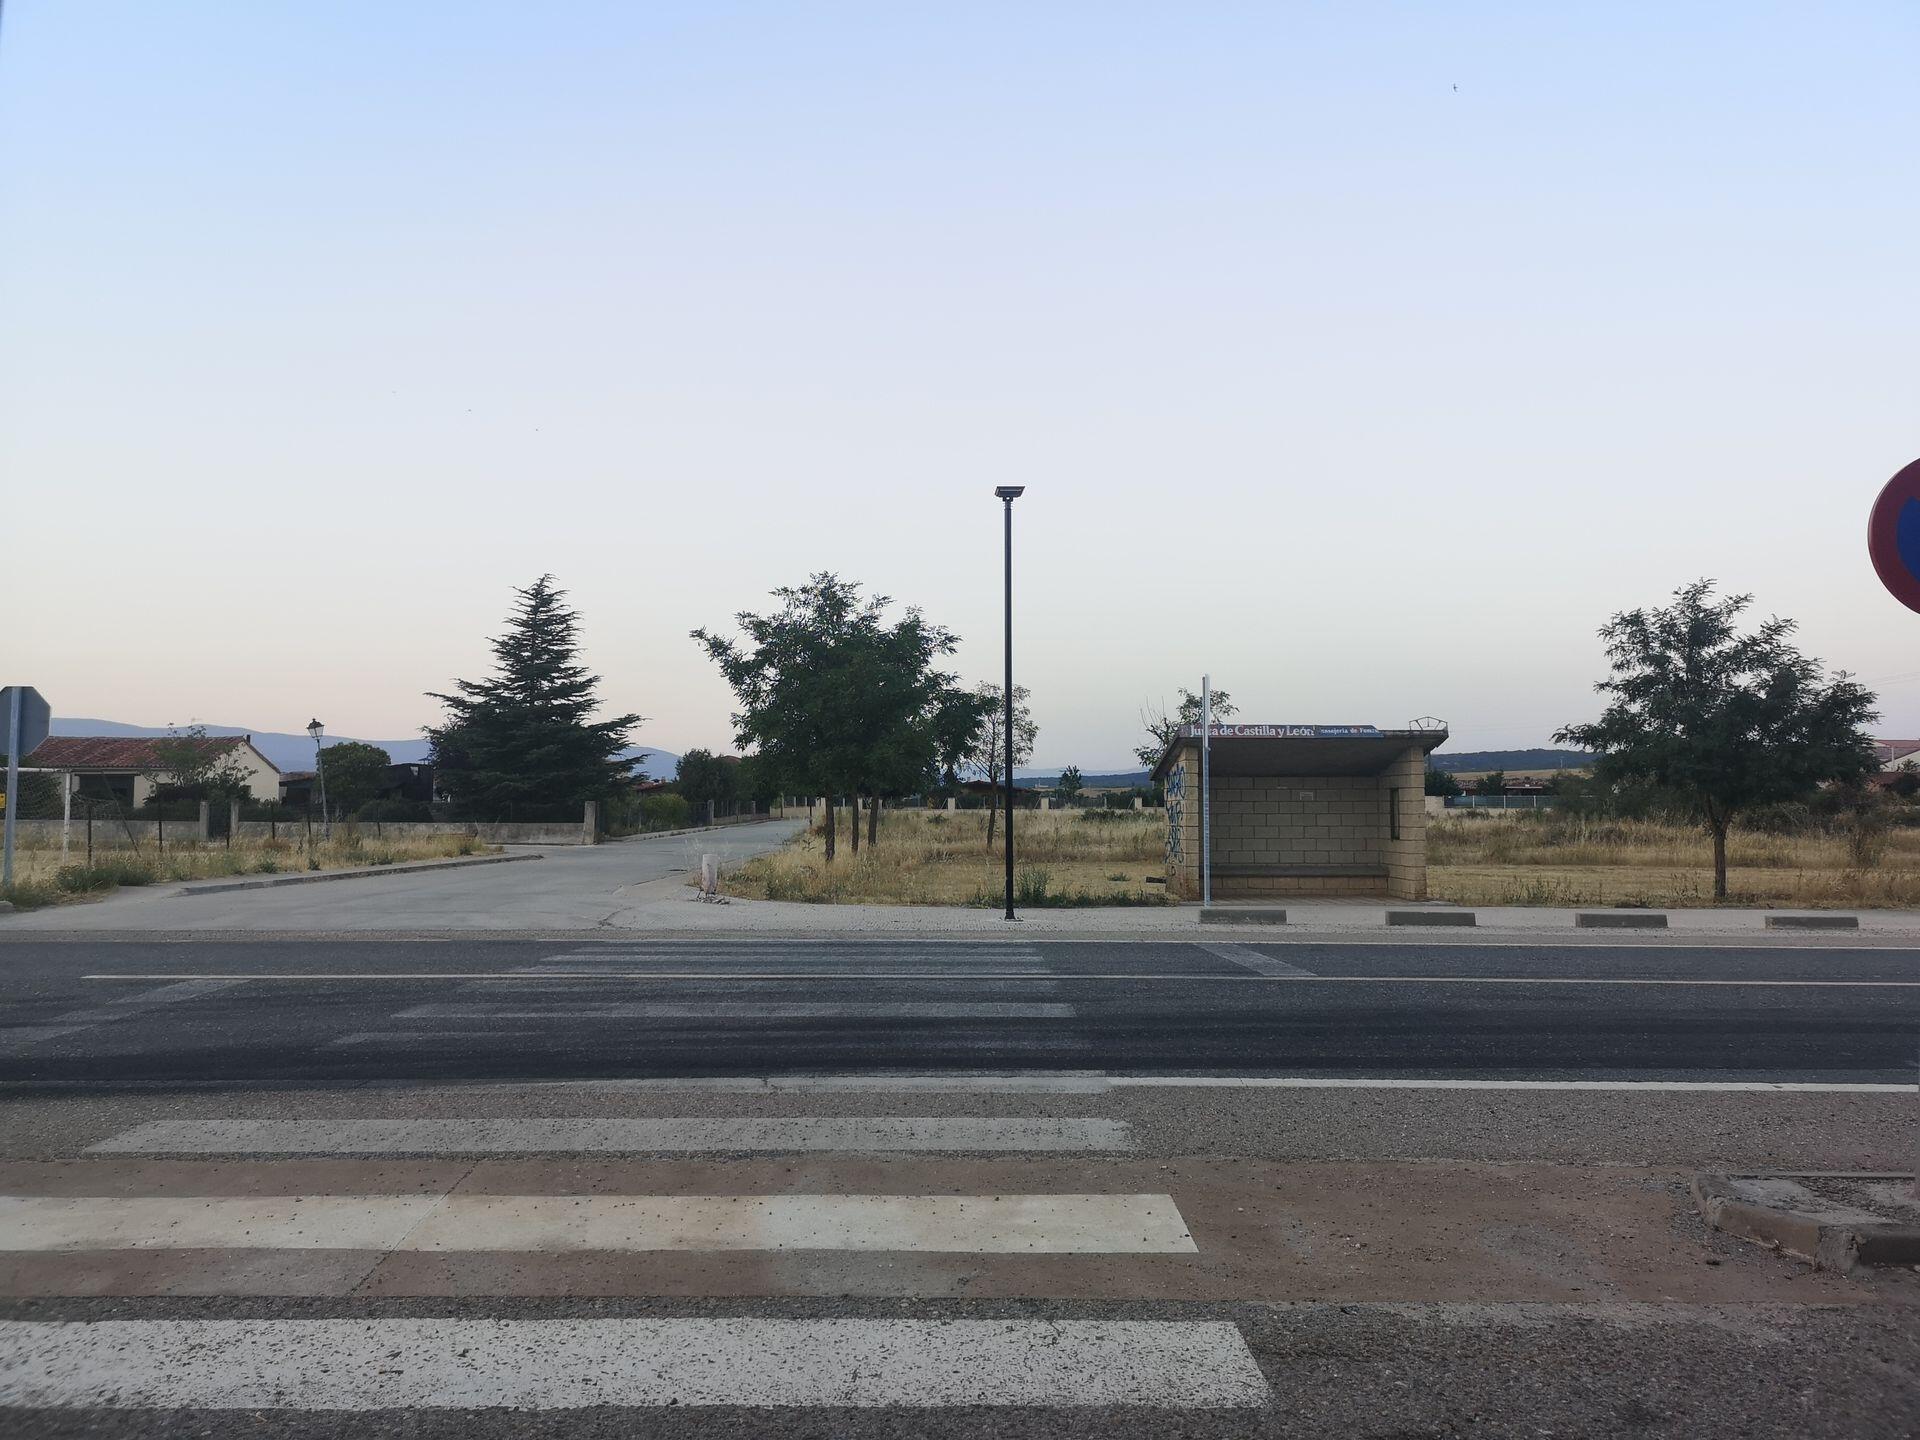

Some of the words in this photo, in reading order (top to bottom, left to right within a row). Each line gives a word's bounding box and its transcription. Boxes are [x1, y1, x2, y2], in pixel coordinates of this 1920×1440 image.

[1190, 725, 1218, 737] Jua
[1220, 725, 1234, 736] de
[1235, 725, 1275, 736] Castilla
[1277, 728, 1285, 738] y
[1286, 725, 1314, 736] León
